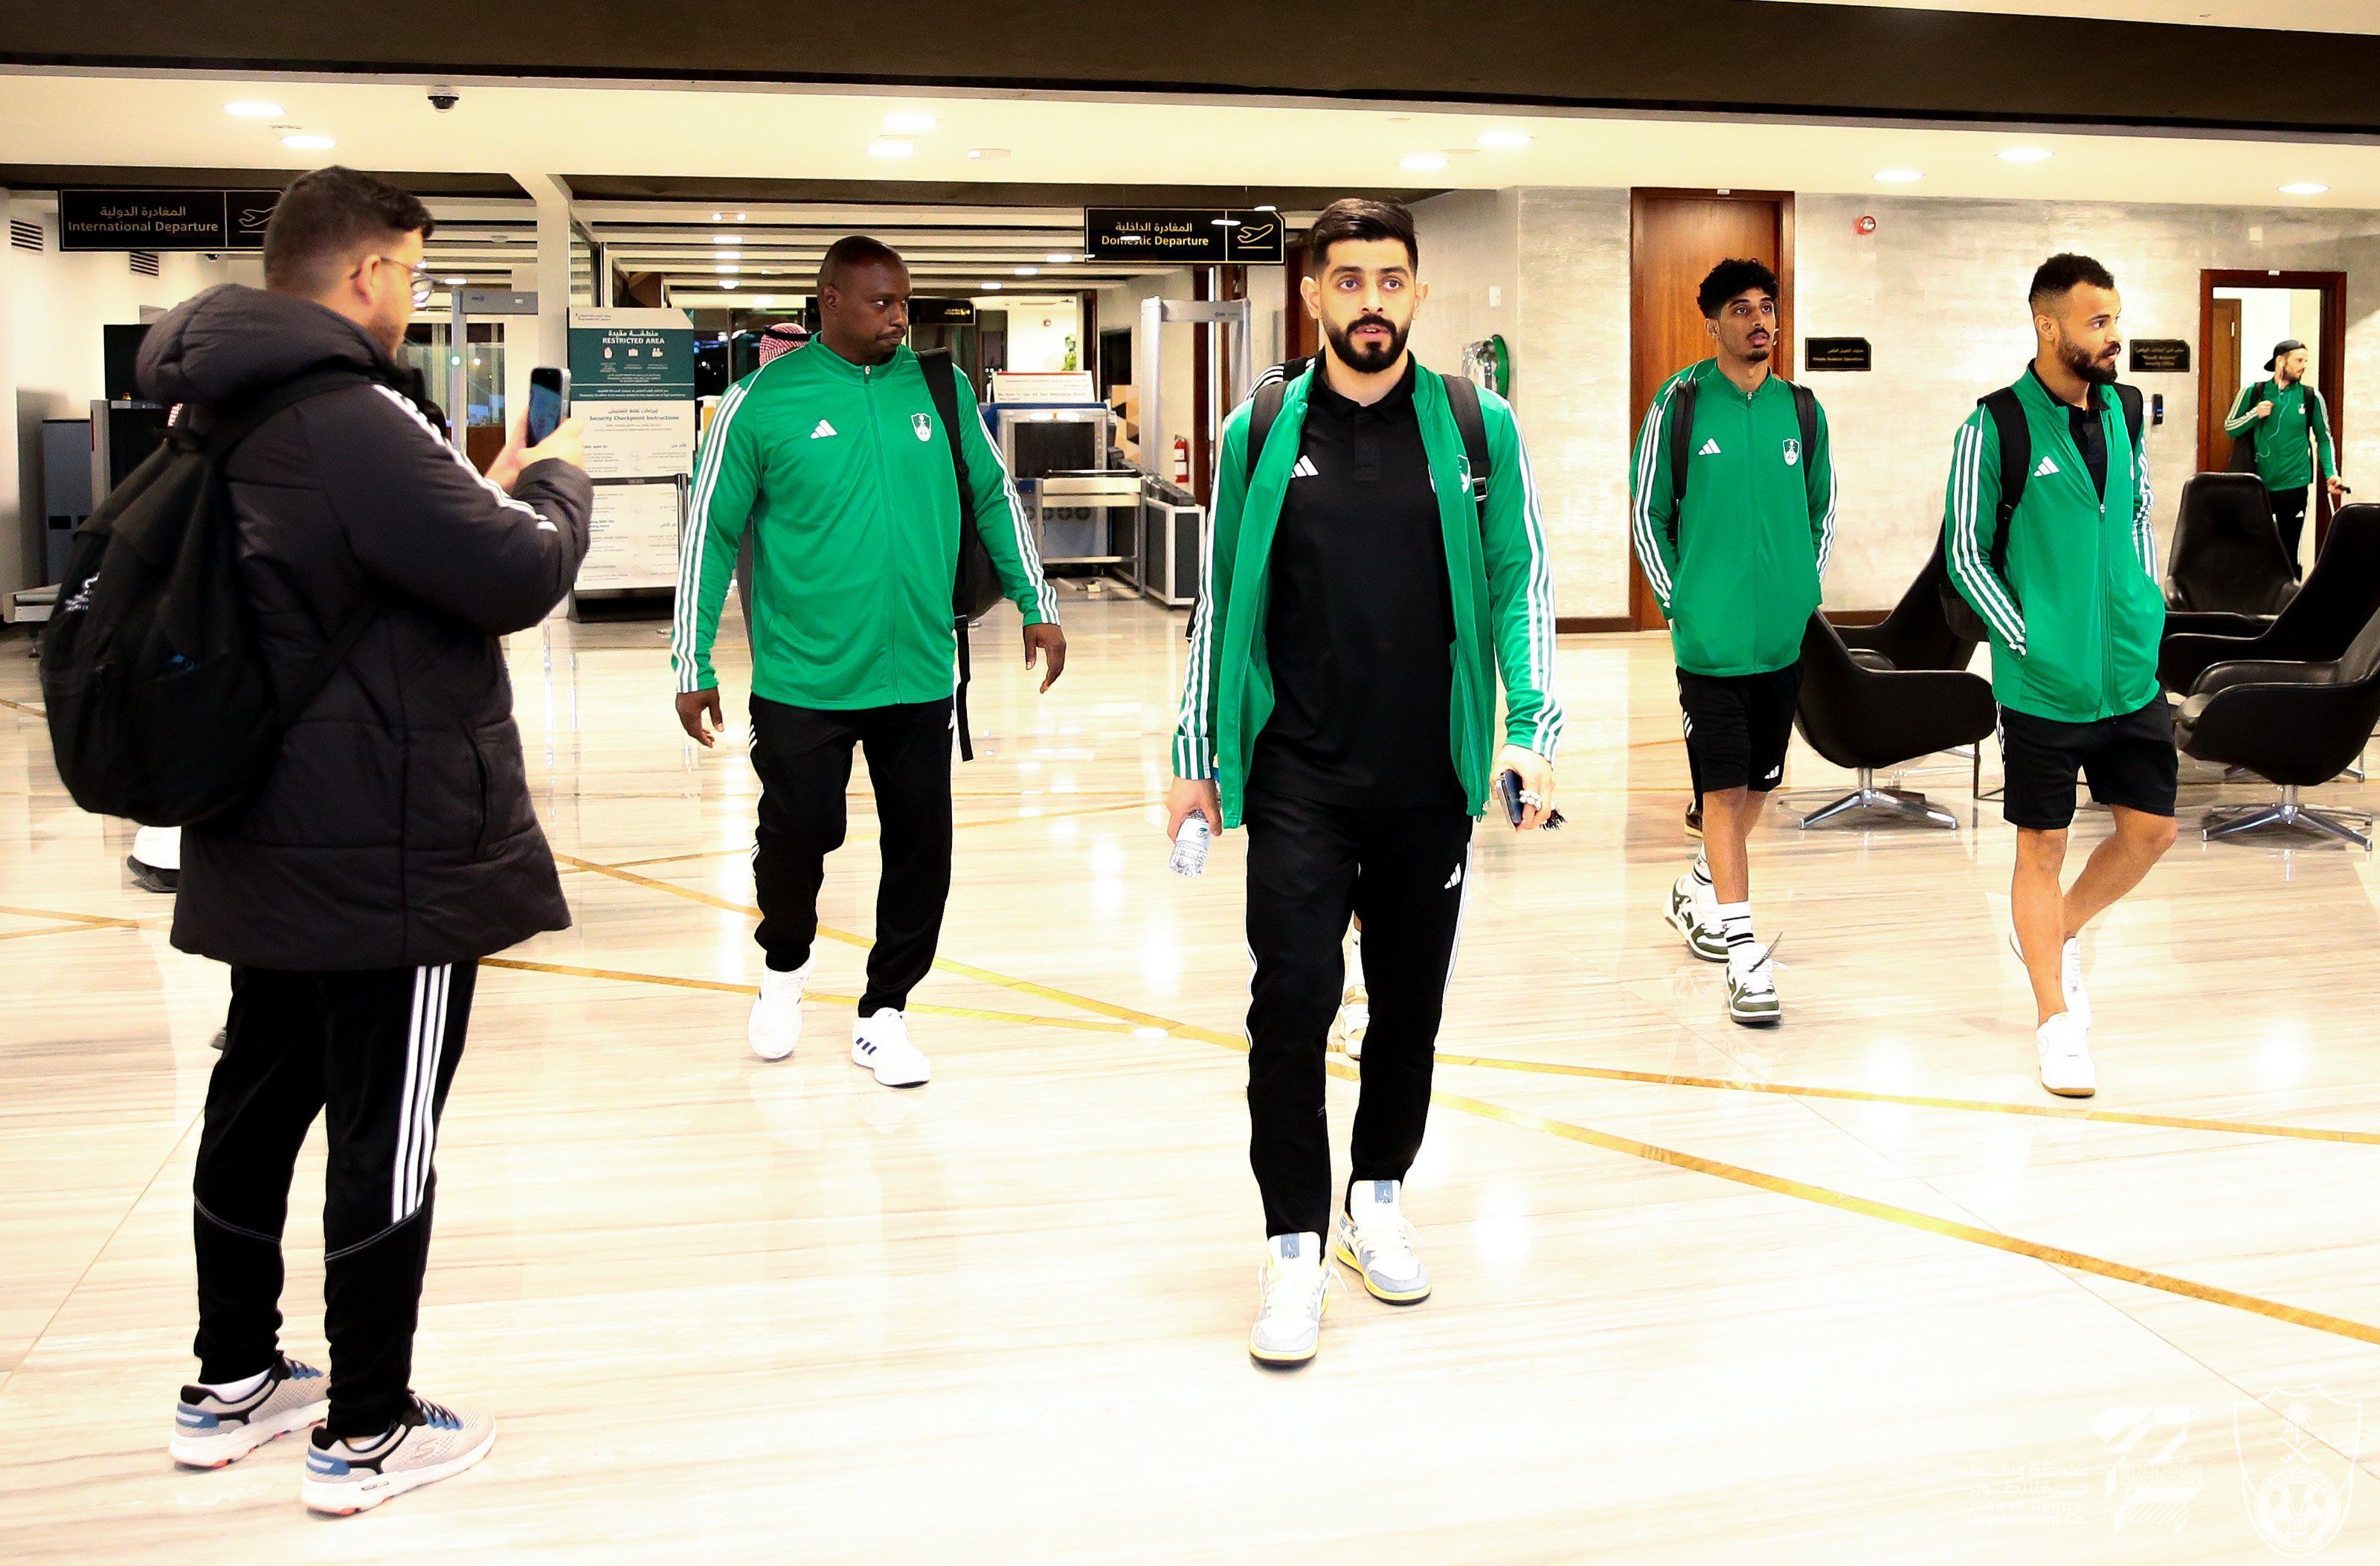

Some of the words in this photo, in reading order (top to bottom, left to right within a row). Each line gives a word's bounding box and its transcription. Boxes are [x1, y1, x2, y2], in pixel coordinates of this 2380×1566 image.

[100, 206, 138, 219] الدولية
[141, 206, 186, 219] المغادرة
[68, 222, 150, 231] International
[155, 222, 219, 233] Departure
[1116, 222, 1151, 233] الداخلية
[1154, 222, 1192, 233] المغادرة
[1154, 236, 1209, 247] Departure
